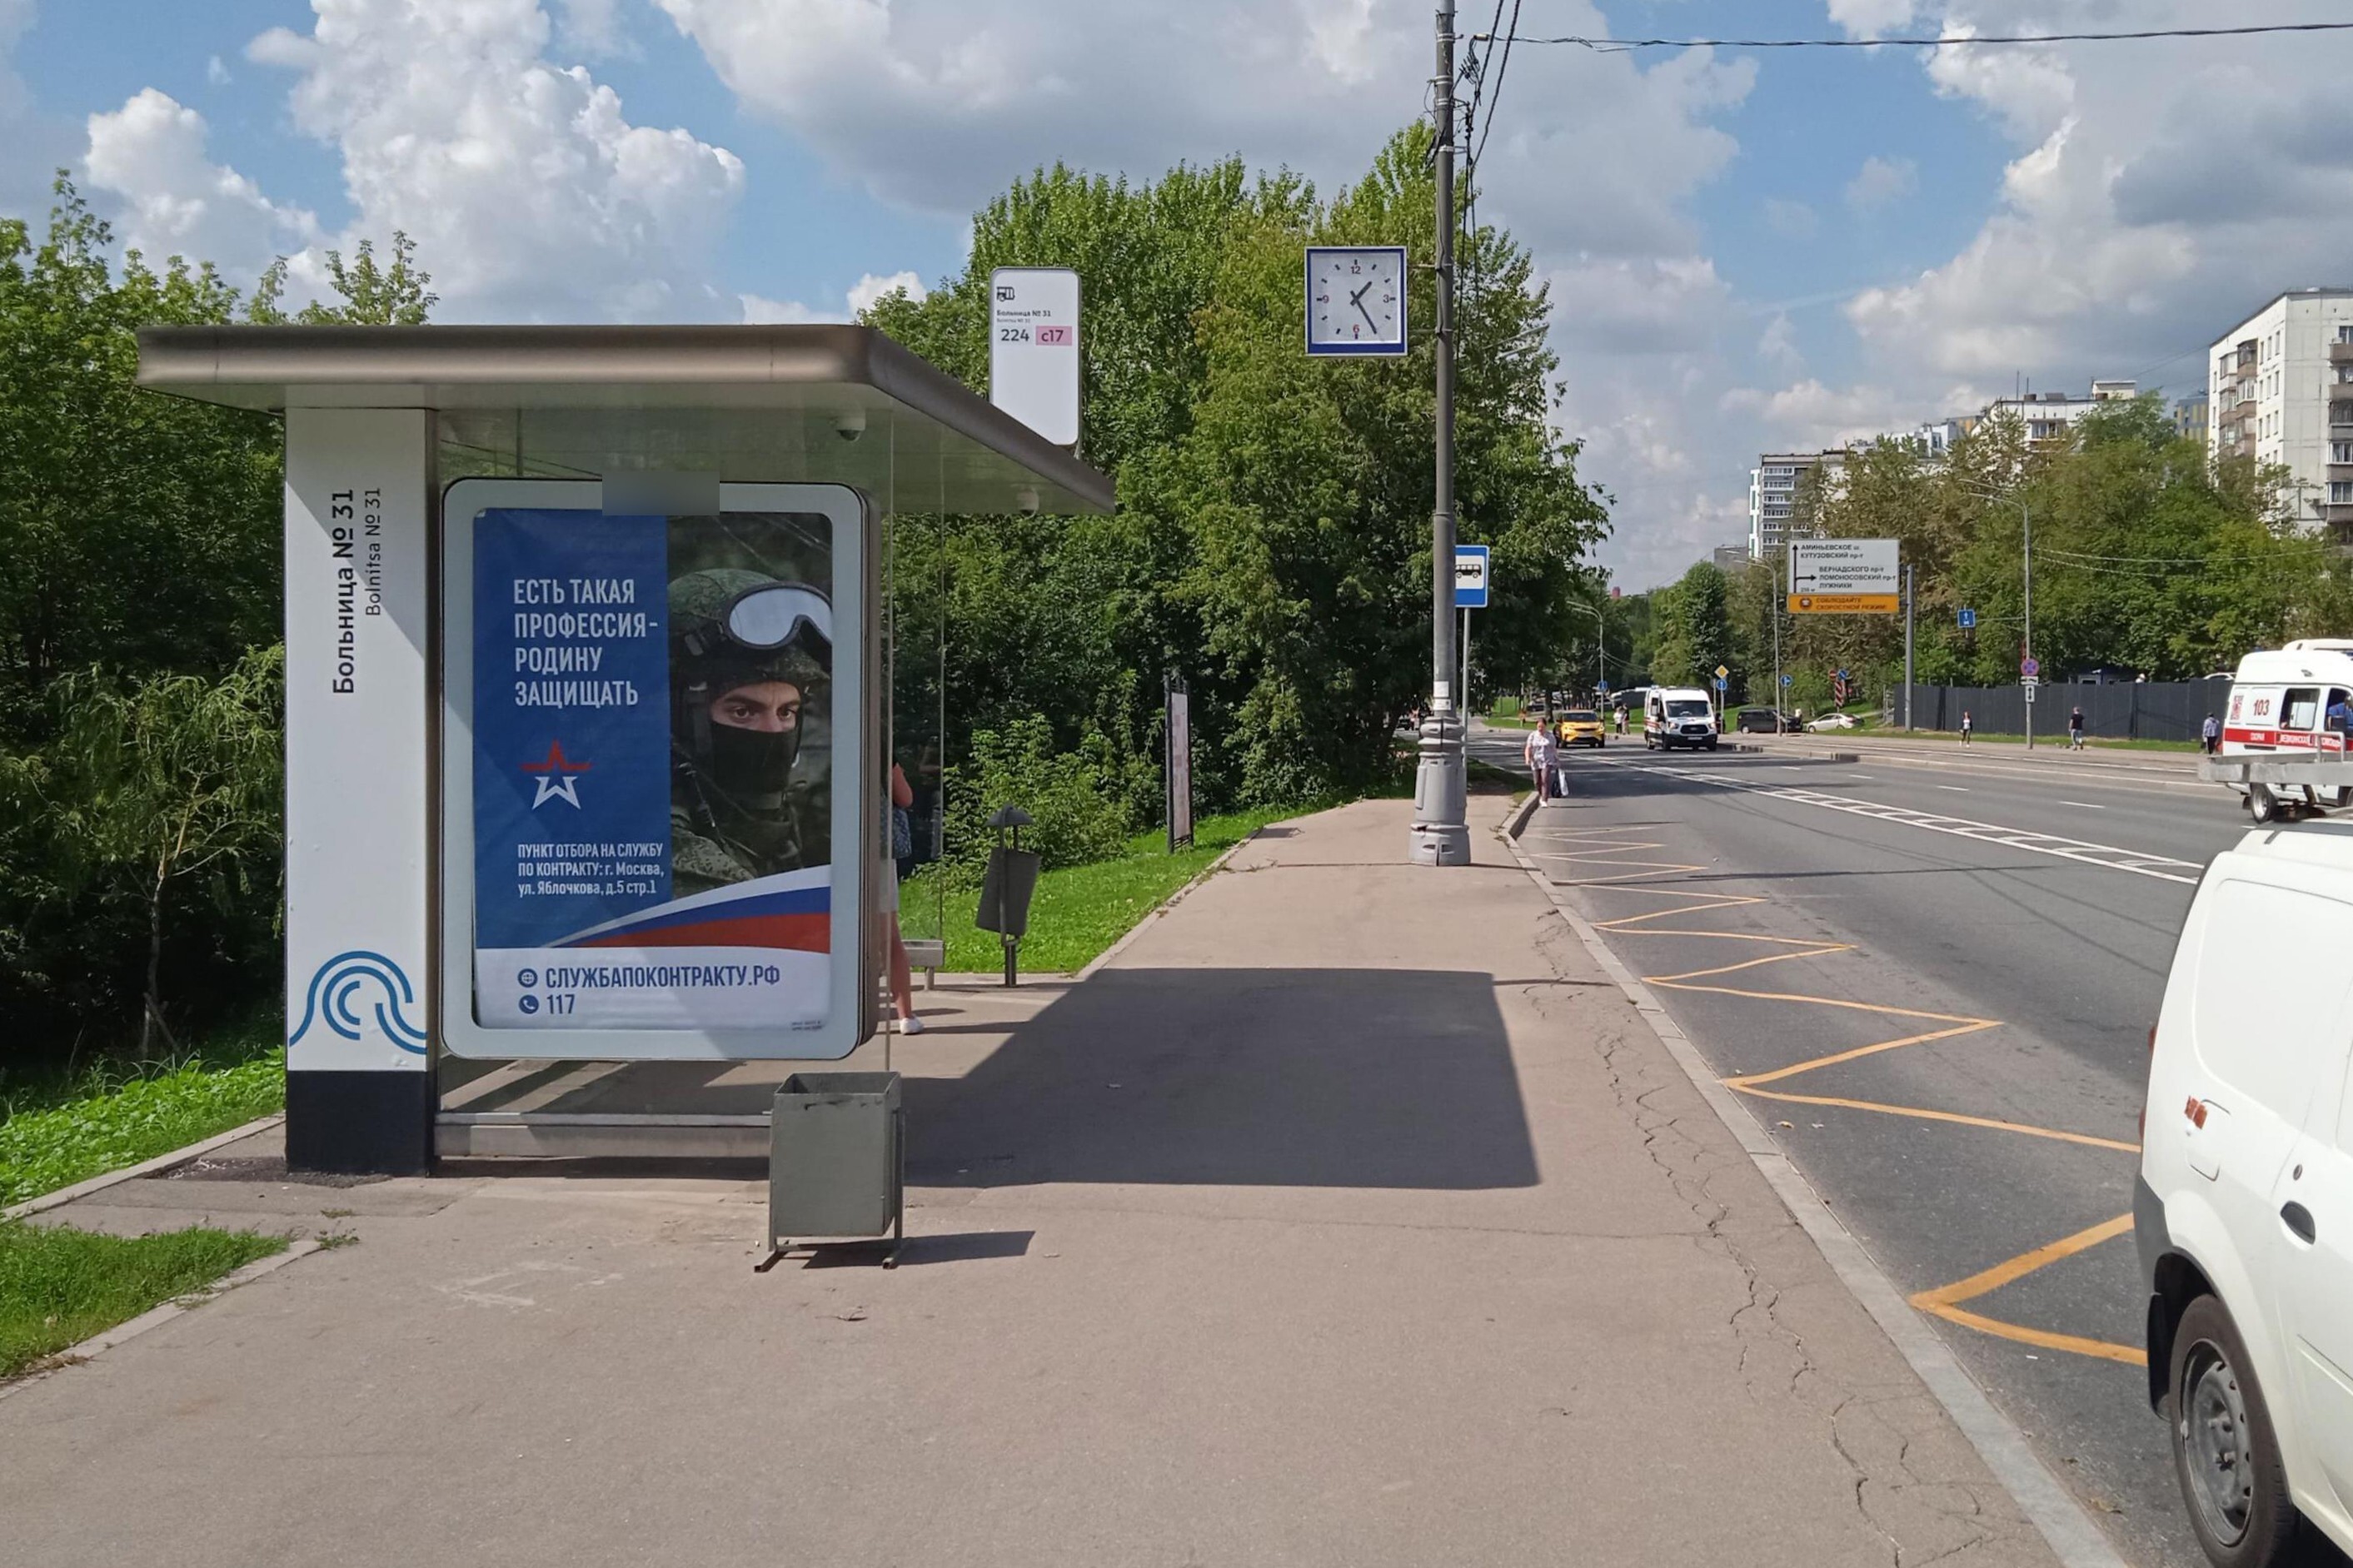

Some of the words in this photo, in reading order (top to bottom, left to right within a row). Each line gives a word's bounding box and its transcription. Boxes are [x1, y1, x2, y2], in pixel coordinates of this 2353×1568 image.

[1350, 266, 1361, 275] 12
[1322, 295, 1329, 303] 9
[1383, 294, 1389, 303] 3
[1000, 329, 1029, 341] 224
[1353, 325, 1359, 334] 6
[332, 489, 354, 520] 31
[365, 488, 381, 509] 31
[365, 543, 381, 615] Bolnitsa
[514, 579, 565, 605] ЕСТЬ
[569, 579, 636, 604] ТАКАЯ
[332, 567, 357, 694] Больница
[515, 646, 603, 675] РОДИНУ
[515, 680, 639, 709] ЗАЩИЩАТЬ
[2253, 699, 2270, 716] 103
[518, 844, 555, 859] ПУНКТ
[556, 844, 599, 858] ОТБОРА
[601, 844, 616, 858] НА
[617, 843, 663, 858] СЛУЖБУ
[518, 863, 534, 877] ПО
[536, 862, 603, 877] КОНТРАКТУ:
[605, 864, 613, 876] г.
[616, 862, 665, 877] Москва,
[518, 883, 536, 898] ул.
[537, 881, 604, 896] Яблочкова,
[626, 880, 656, 897] стр.1
[546, 965, 780, 988] СЛУЖБАПОКОНТРАКТУ.РФ
[546, 994, 576, 1014] 117
